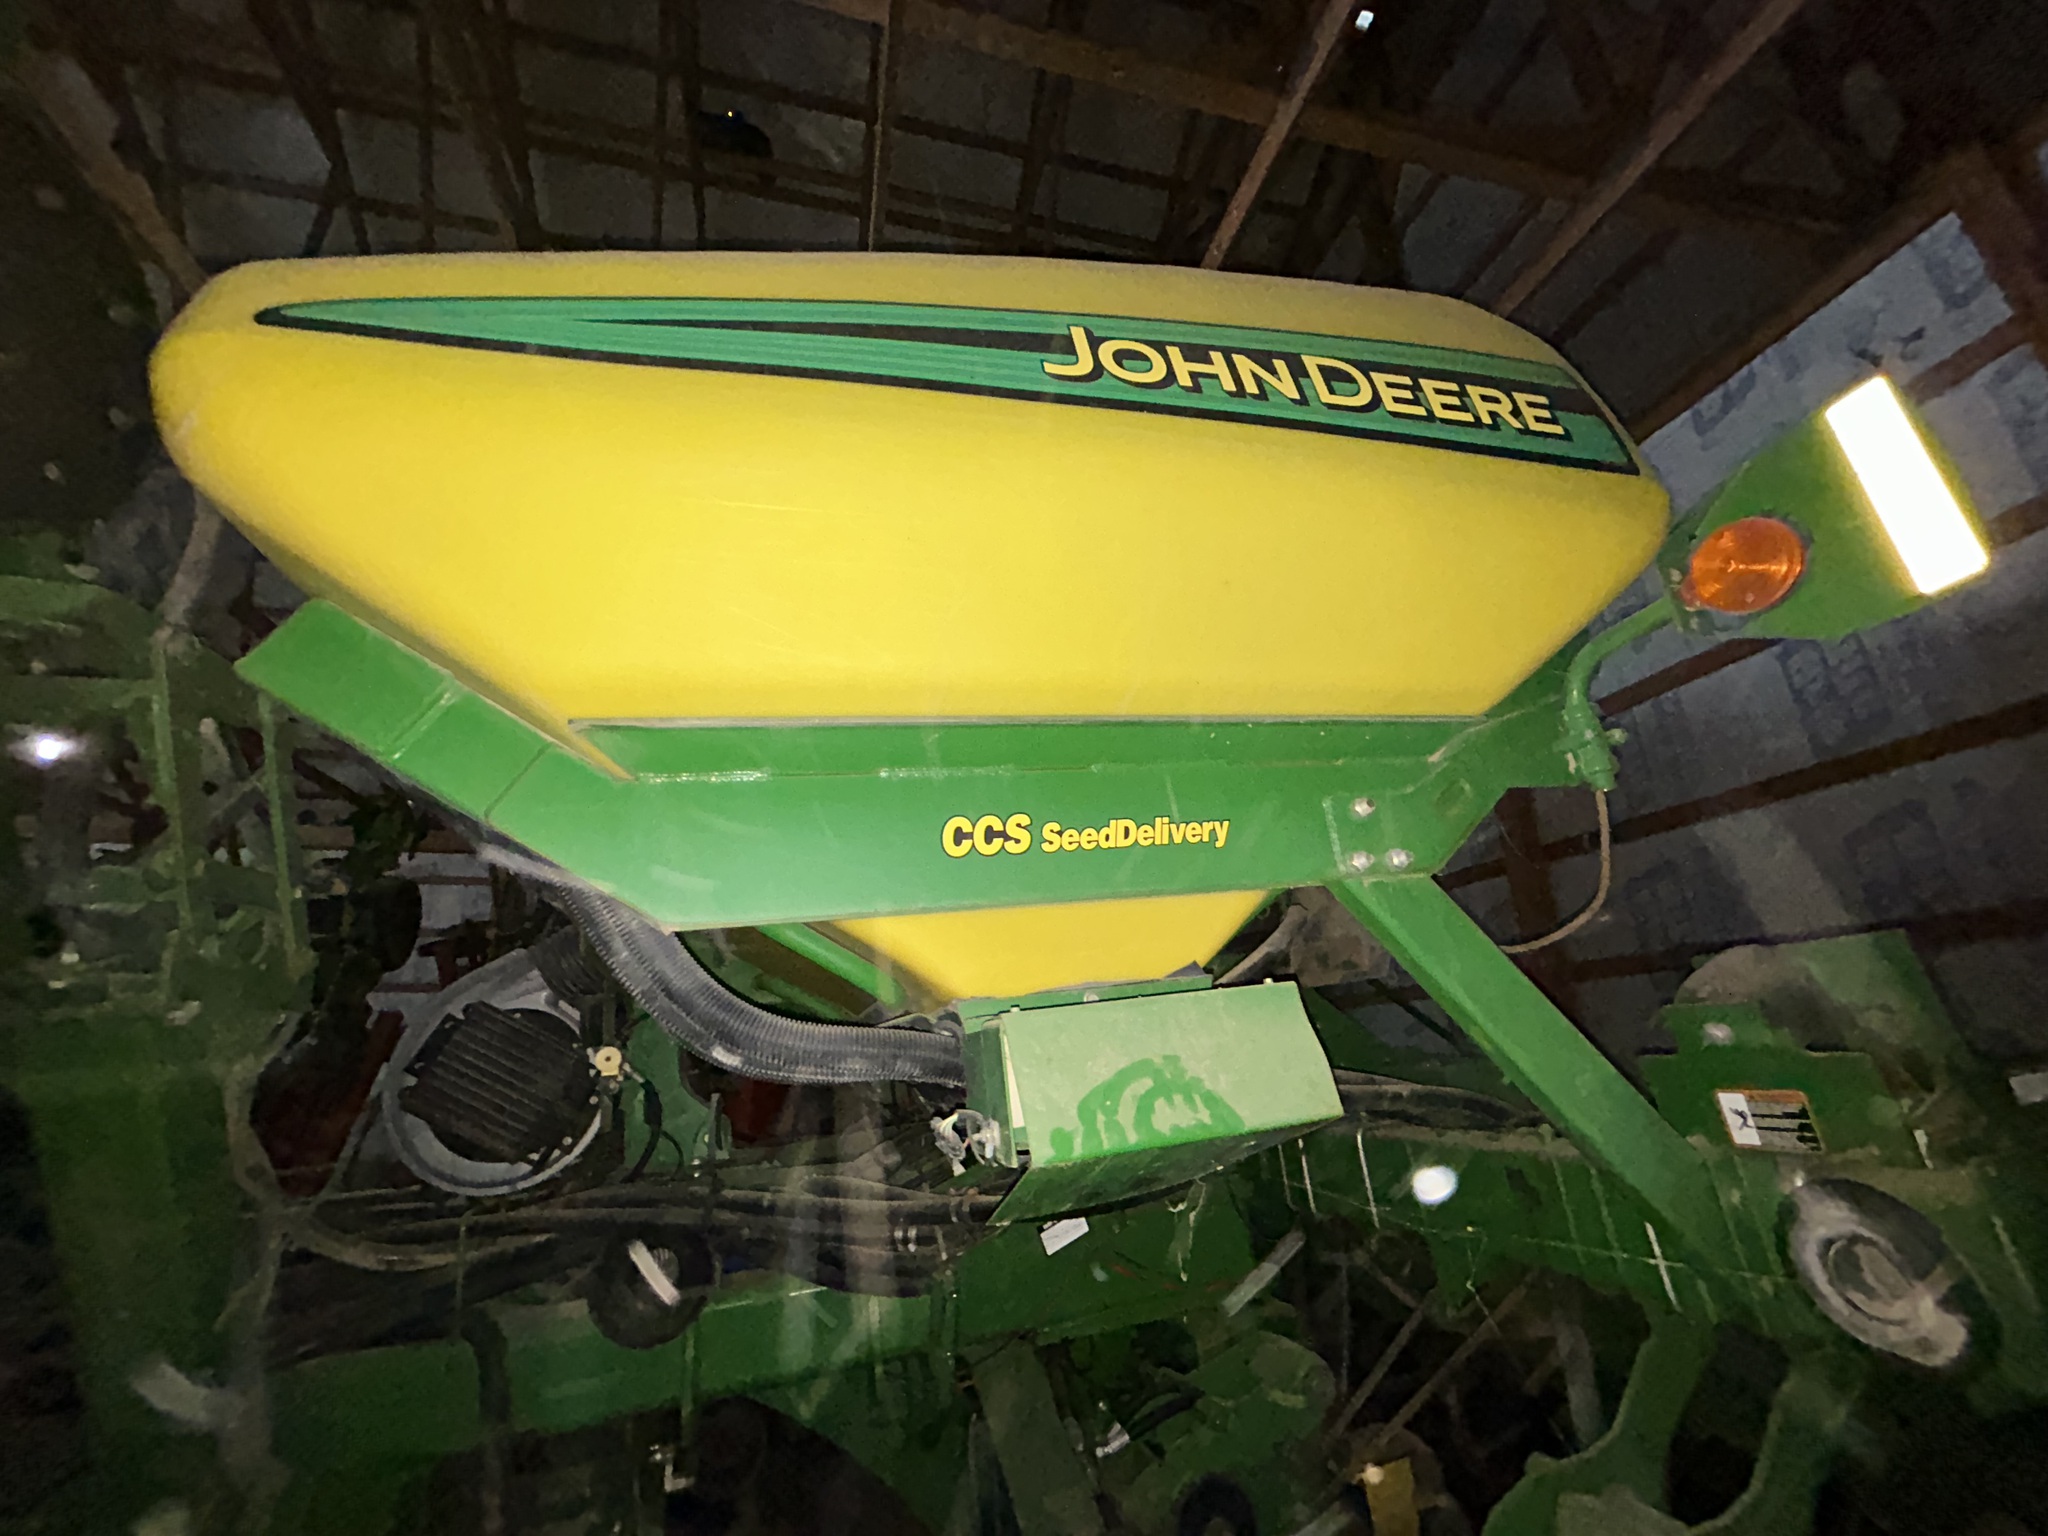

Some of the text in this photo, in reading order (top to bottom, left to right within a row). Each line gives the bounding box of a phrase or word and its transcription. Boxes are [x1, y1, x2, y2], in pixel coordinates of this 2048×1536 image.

[1042, 325, 1566, 437] JOHN DEERE
[942, 813, 1231, 858] CCS SeedDelivery
